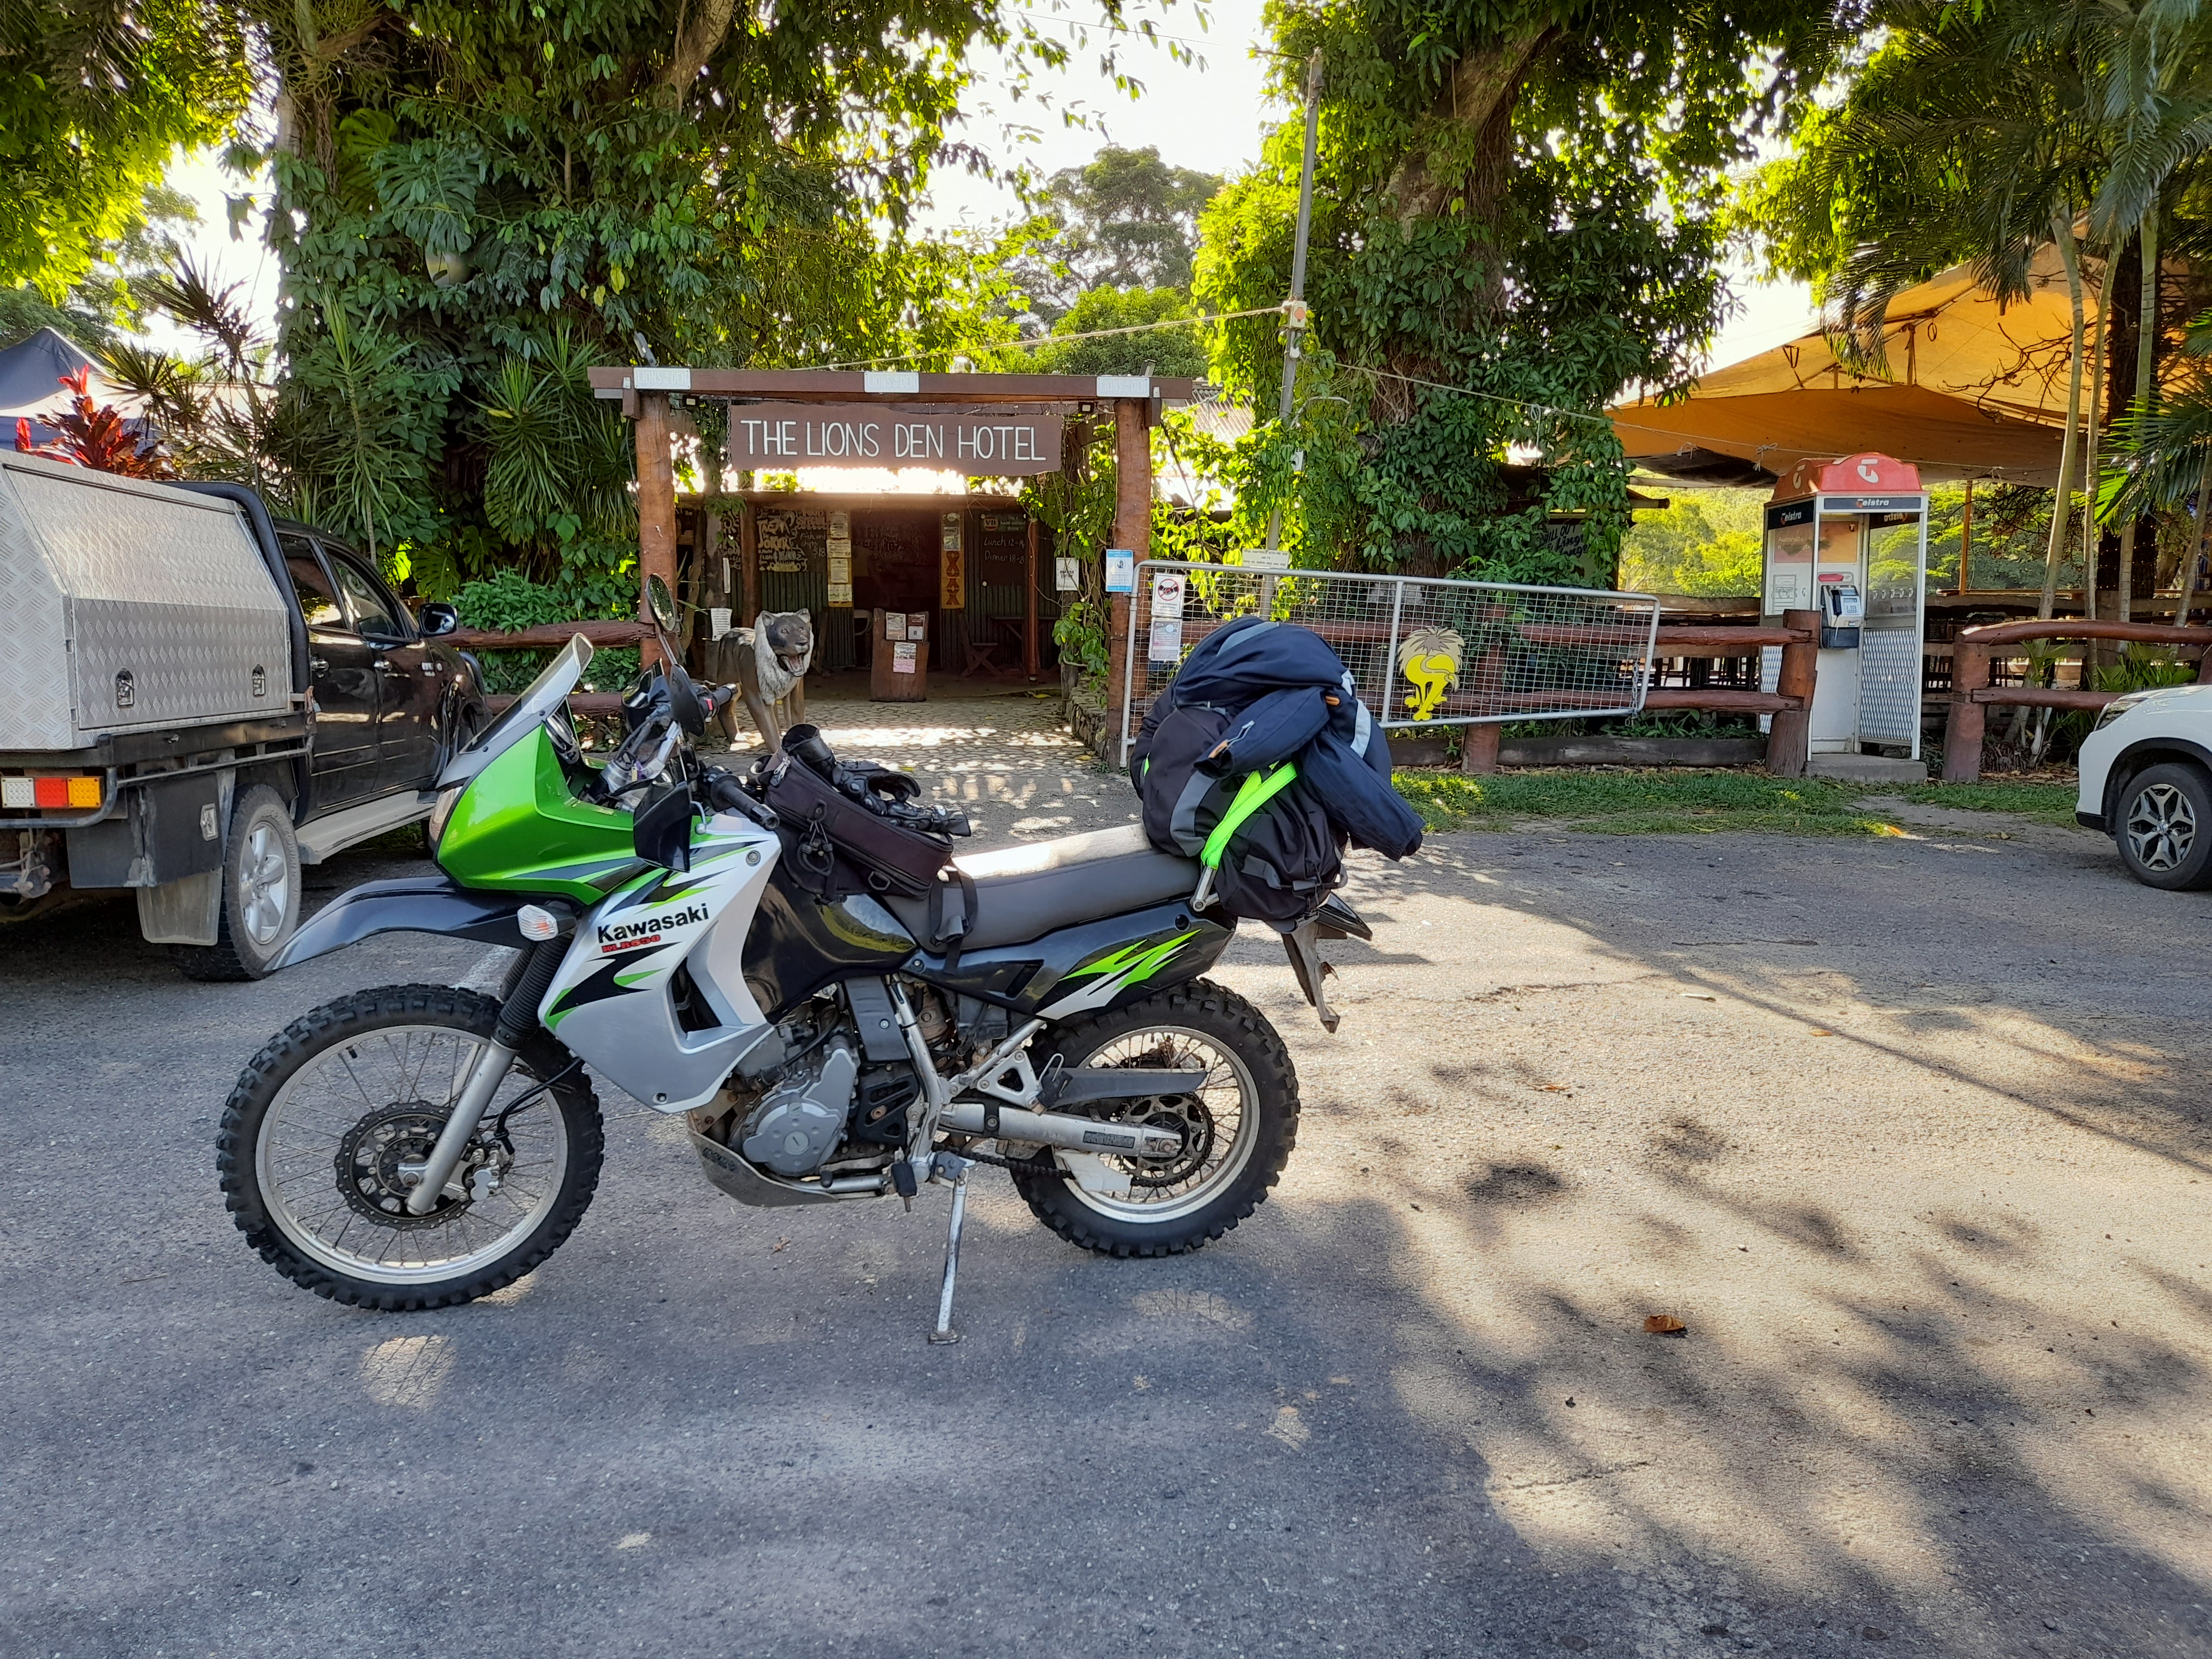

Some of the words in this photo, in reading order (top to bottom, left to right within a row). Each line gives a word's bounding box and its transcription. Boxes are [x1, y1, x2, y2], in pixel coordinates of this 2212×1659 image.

[638, 371, 662, 384] LIONS
[671, 372, 686, 384] DEN
[740, 420, 798, 456] THE
[806, 420, 880, 458] LIONS
[894, 423, 943, 459] DEN
[958, 424, 1047, 462] HOTEL
[1856, 498, 1890, 508] Telstra
[1780, 510, 1802, 525] Telstra
[800, 531, 814, 540] Fish
[984, 535, 1006, 547] Lunch
[984, 550, 1008, 562] Dinner
[597, 903, 709, 943] Kawasaki
[601, 934, 661, 953] KLR650
